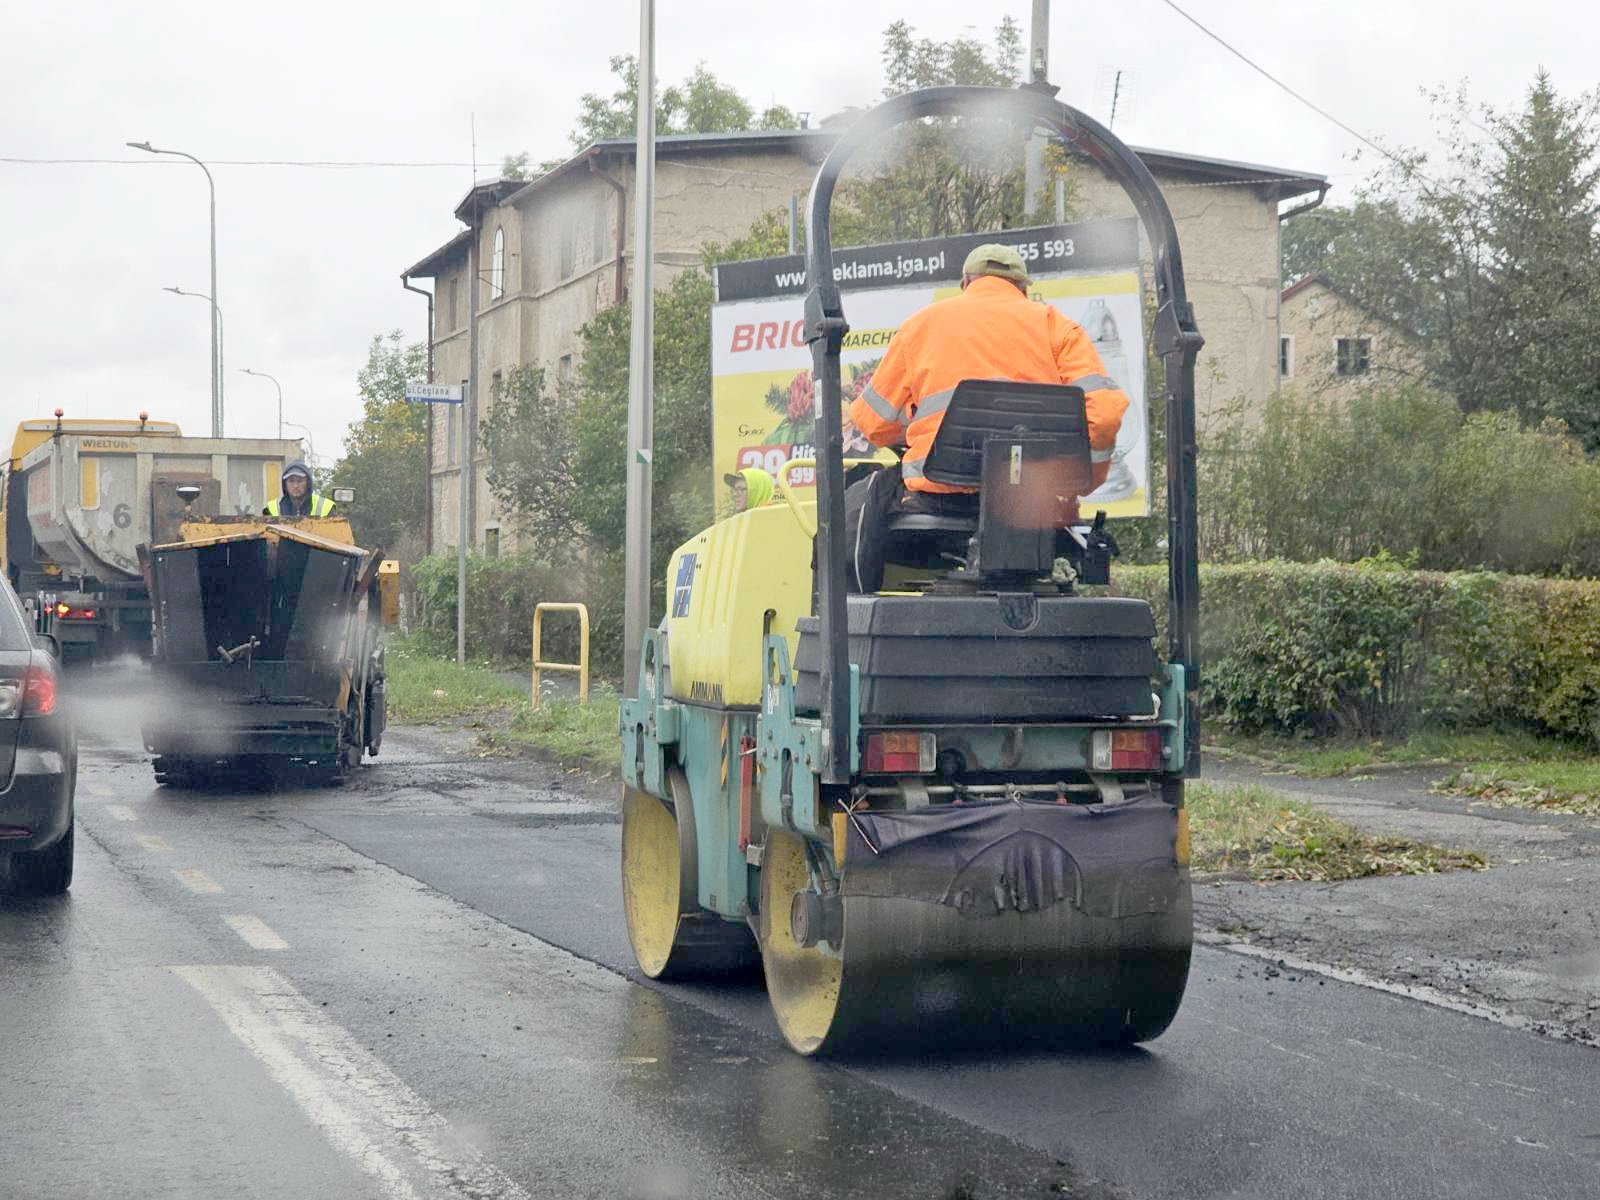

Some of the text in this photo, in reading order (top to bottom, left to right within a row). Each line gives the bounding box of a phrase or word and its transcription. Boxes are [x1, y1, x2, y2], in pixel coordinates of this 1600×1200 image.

[775, 251, 945, 288] wweklama.jga.pl
[1044, 239, 1074, 258] 593
[841, 330, 898, 347] MARCH
[82, 439, 129, 449] WIELTON
[112, 503, 132, 528] 6
[690, 680, 723, 703] AMMANN
